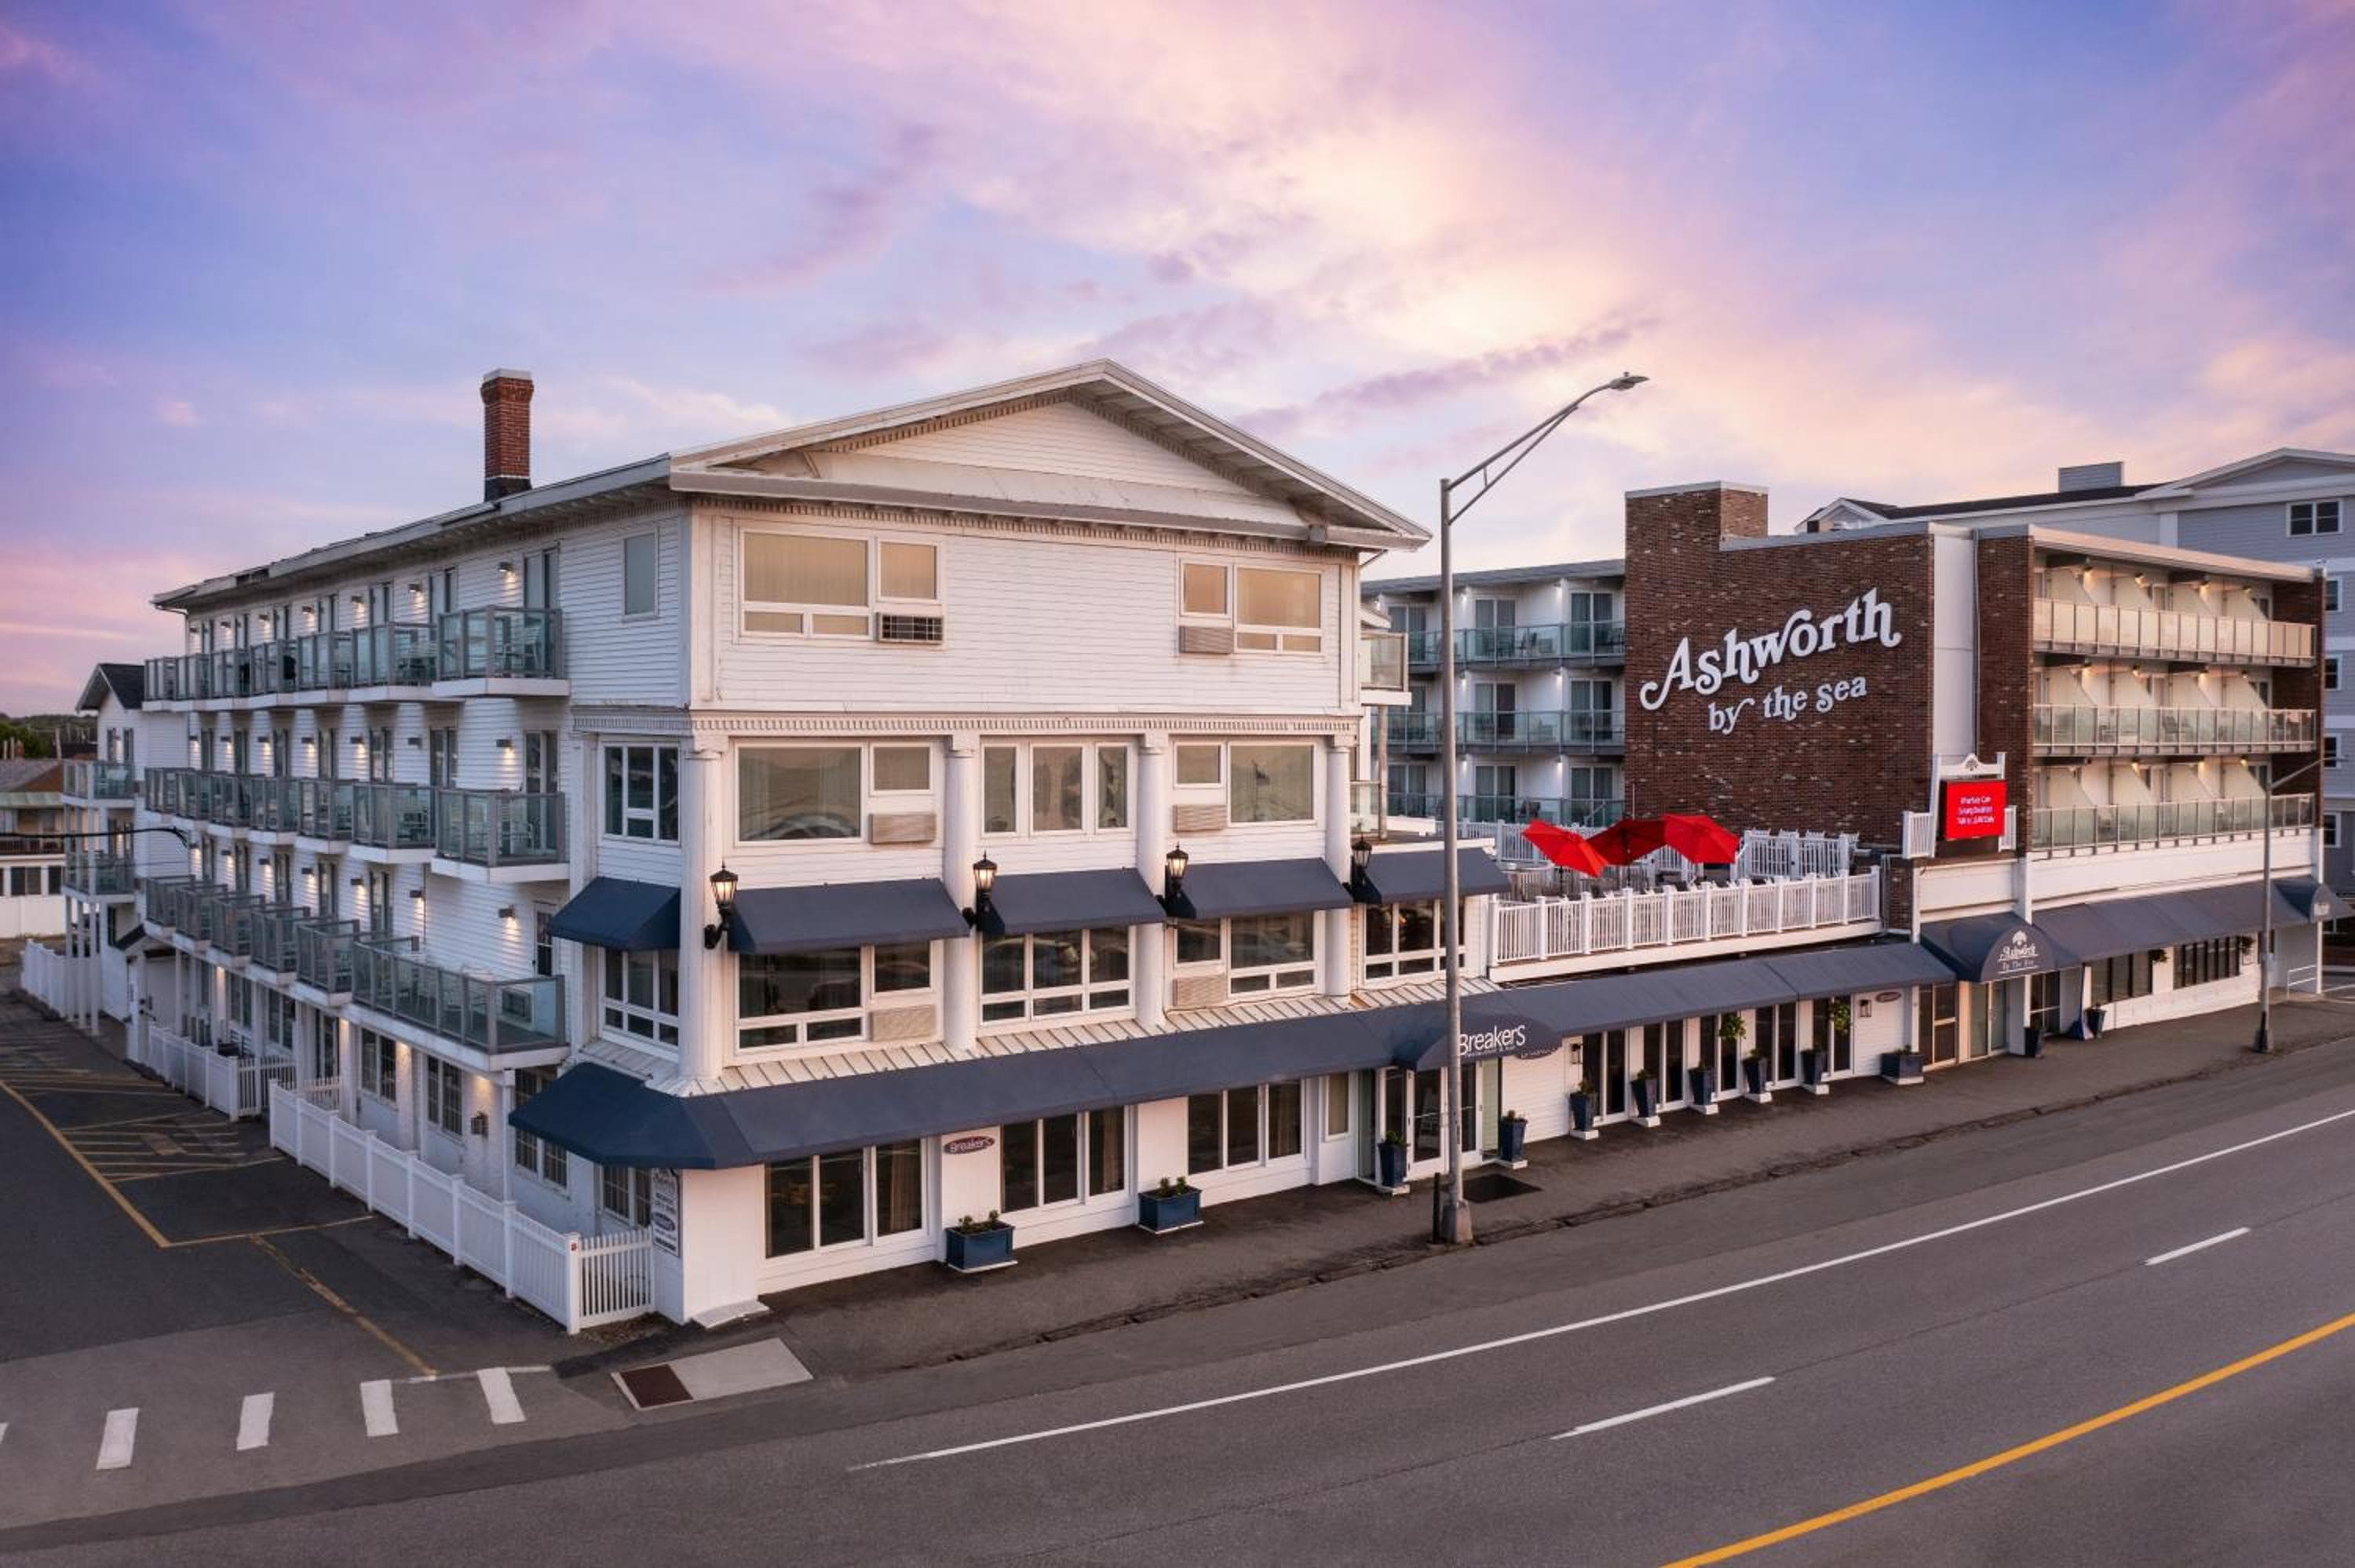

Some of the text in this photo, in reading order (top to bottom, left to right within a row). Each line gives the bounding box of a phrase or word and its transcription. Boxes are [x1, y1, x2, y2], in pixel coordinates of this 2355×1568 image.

[1639, 587, 1903, 710] Ashworth
[1707, 676, 1868, 735] by the sea
